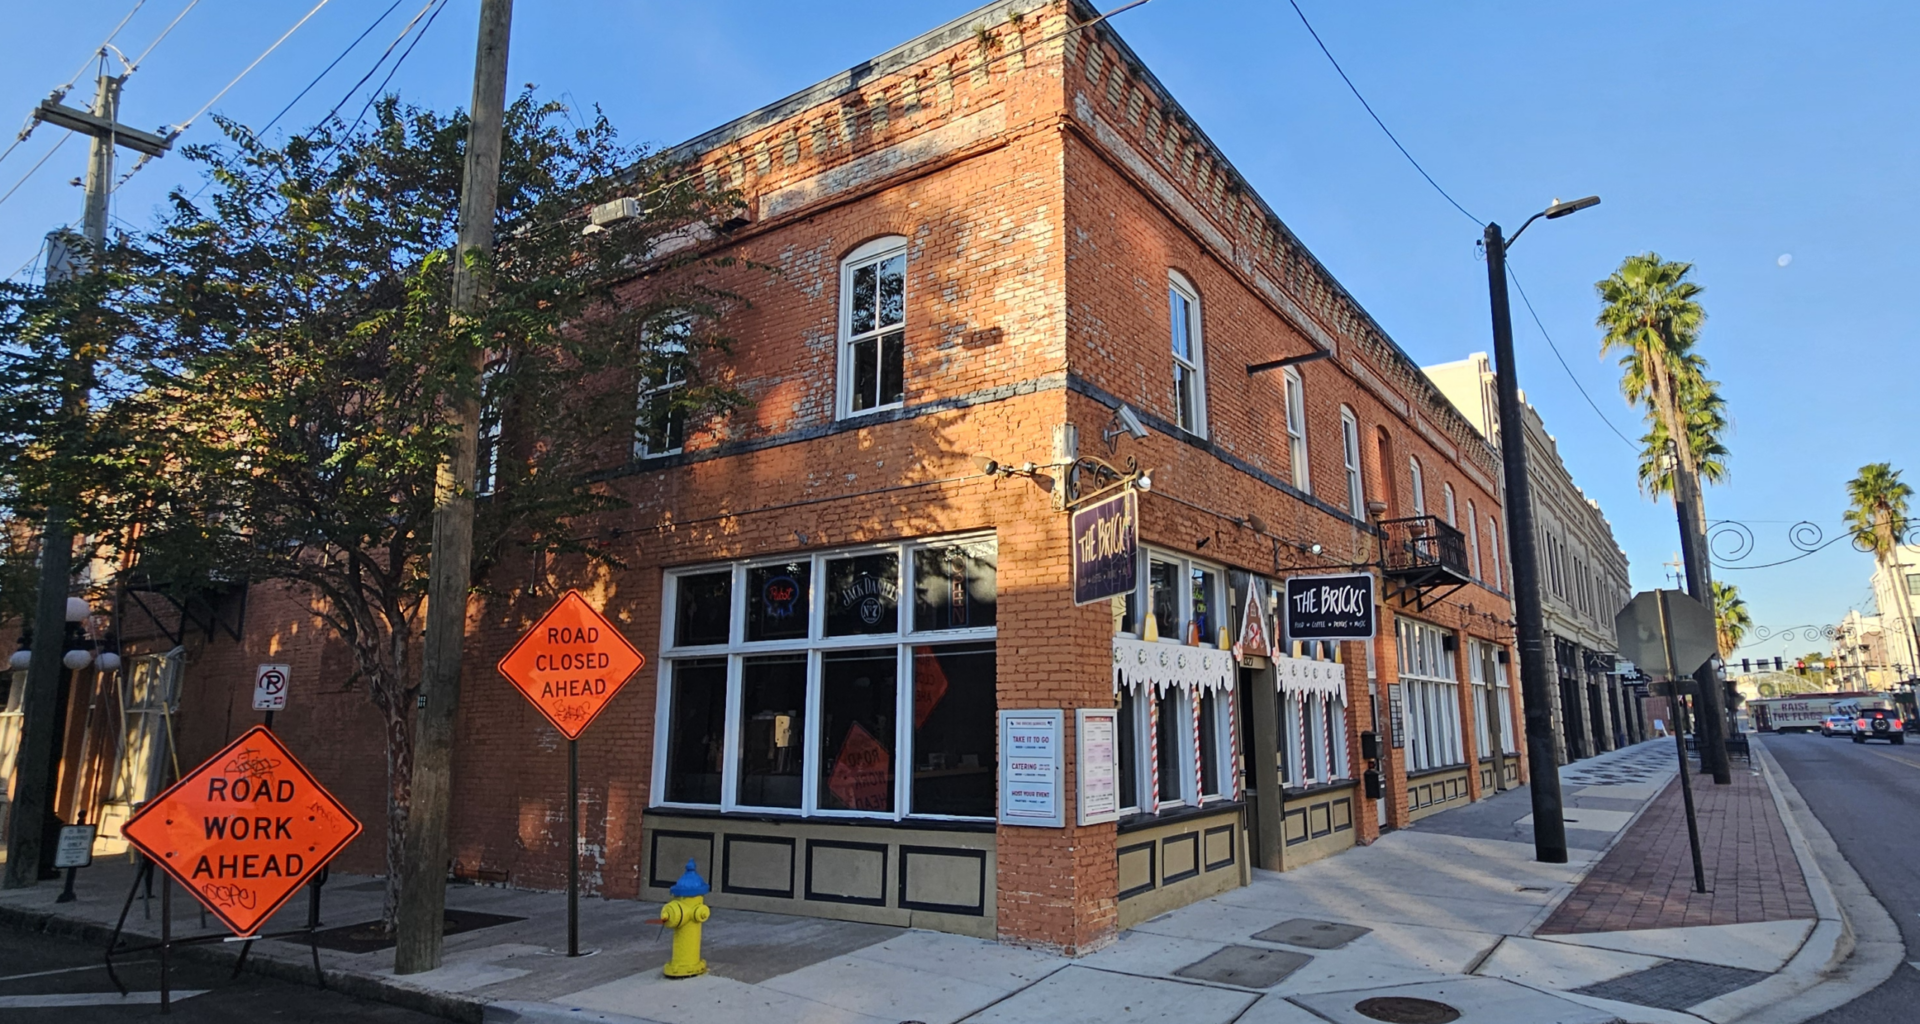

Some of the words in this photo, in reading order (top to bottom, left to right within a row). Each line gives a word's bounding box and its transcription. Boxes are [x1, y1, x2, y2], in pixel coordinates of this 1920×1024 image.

[1078, 524, 1097, 563] THE
[842, 584, 864, 607] JACK
[1293, 588, 1318, 613] THE
[1321, 585, 1366, 617] BRICKS
[548, 627, 599, 644] ROAD
[536, 653, 609, 671] CLOSED
[541, 679, 606, 698] AHEAD
[1772, 713, 1790, 721] THE
[1781, 703, 1809, 711] RAISE
[207, 778, 295, 802] ROAD
[203, 816, 293, 841] WORK
[191, 854, 304, 879] AHEAD
